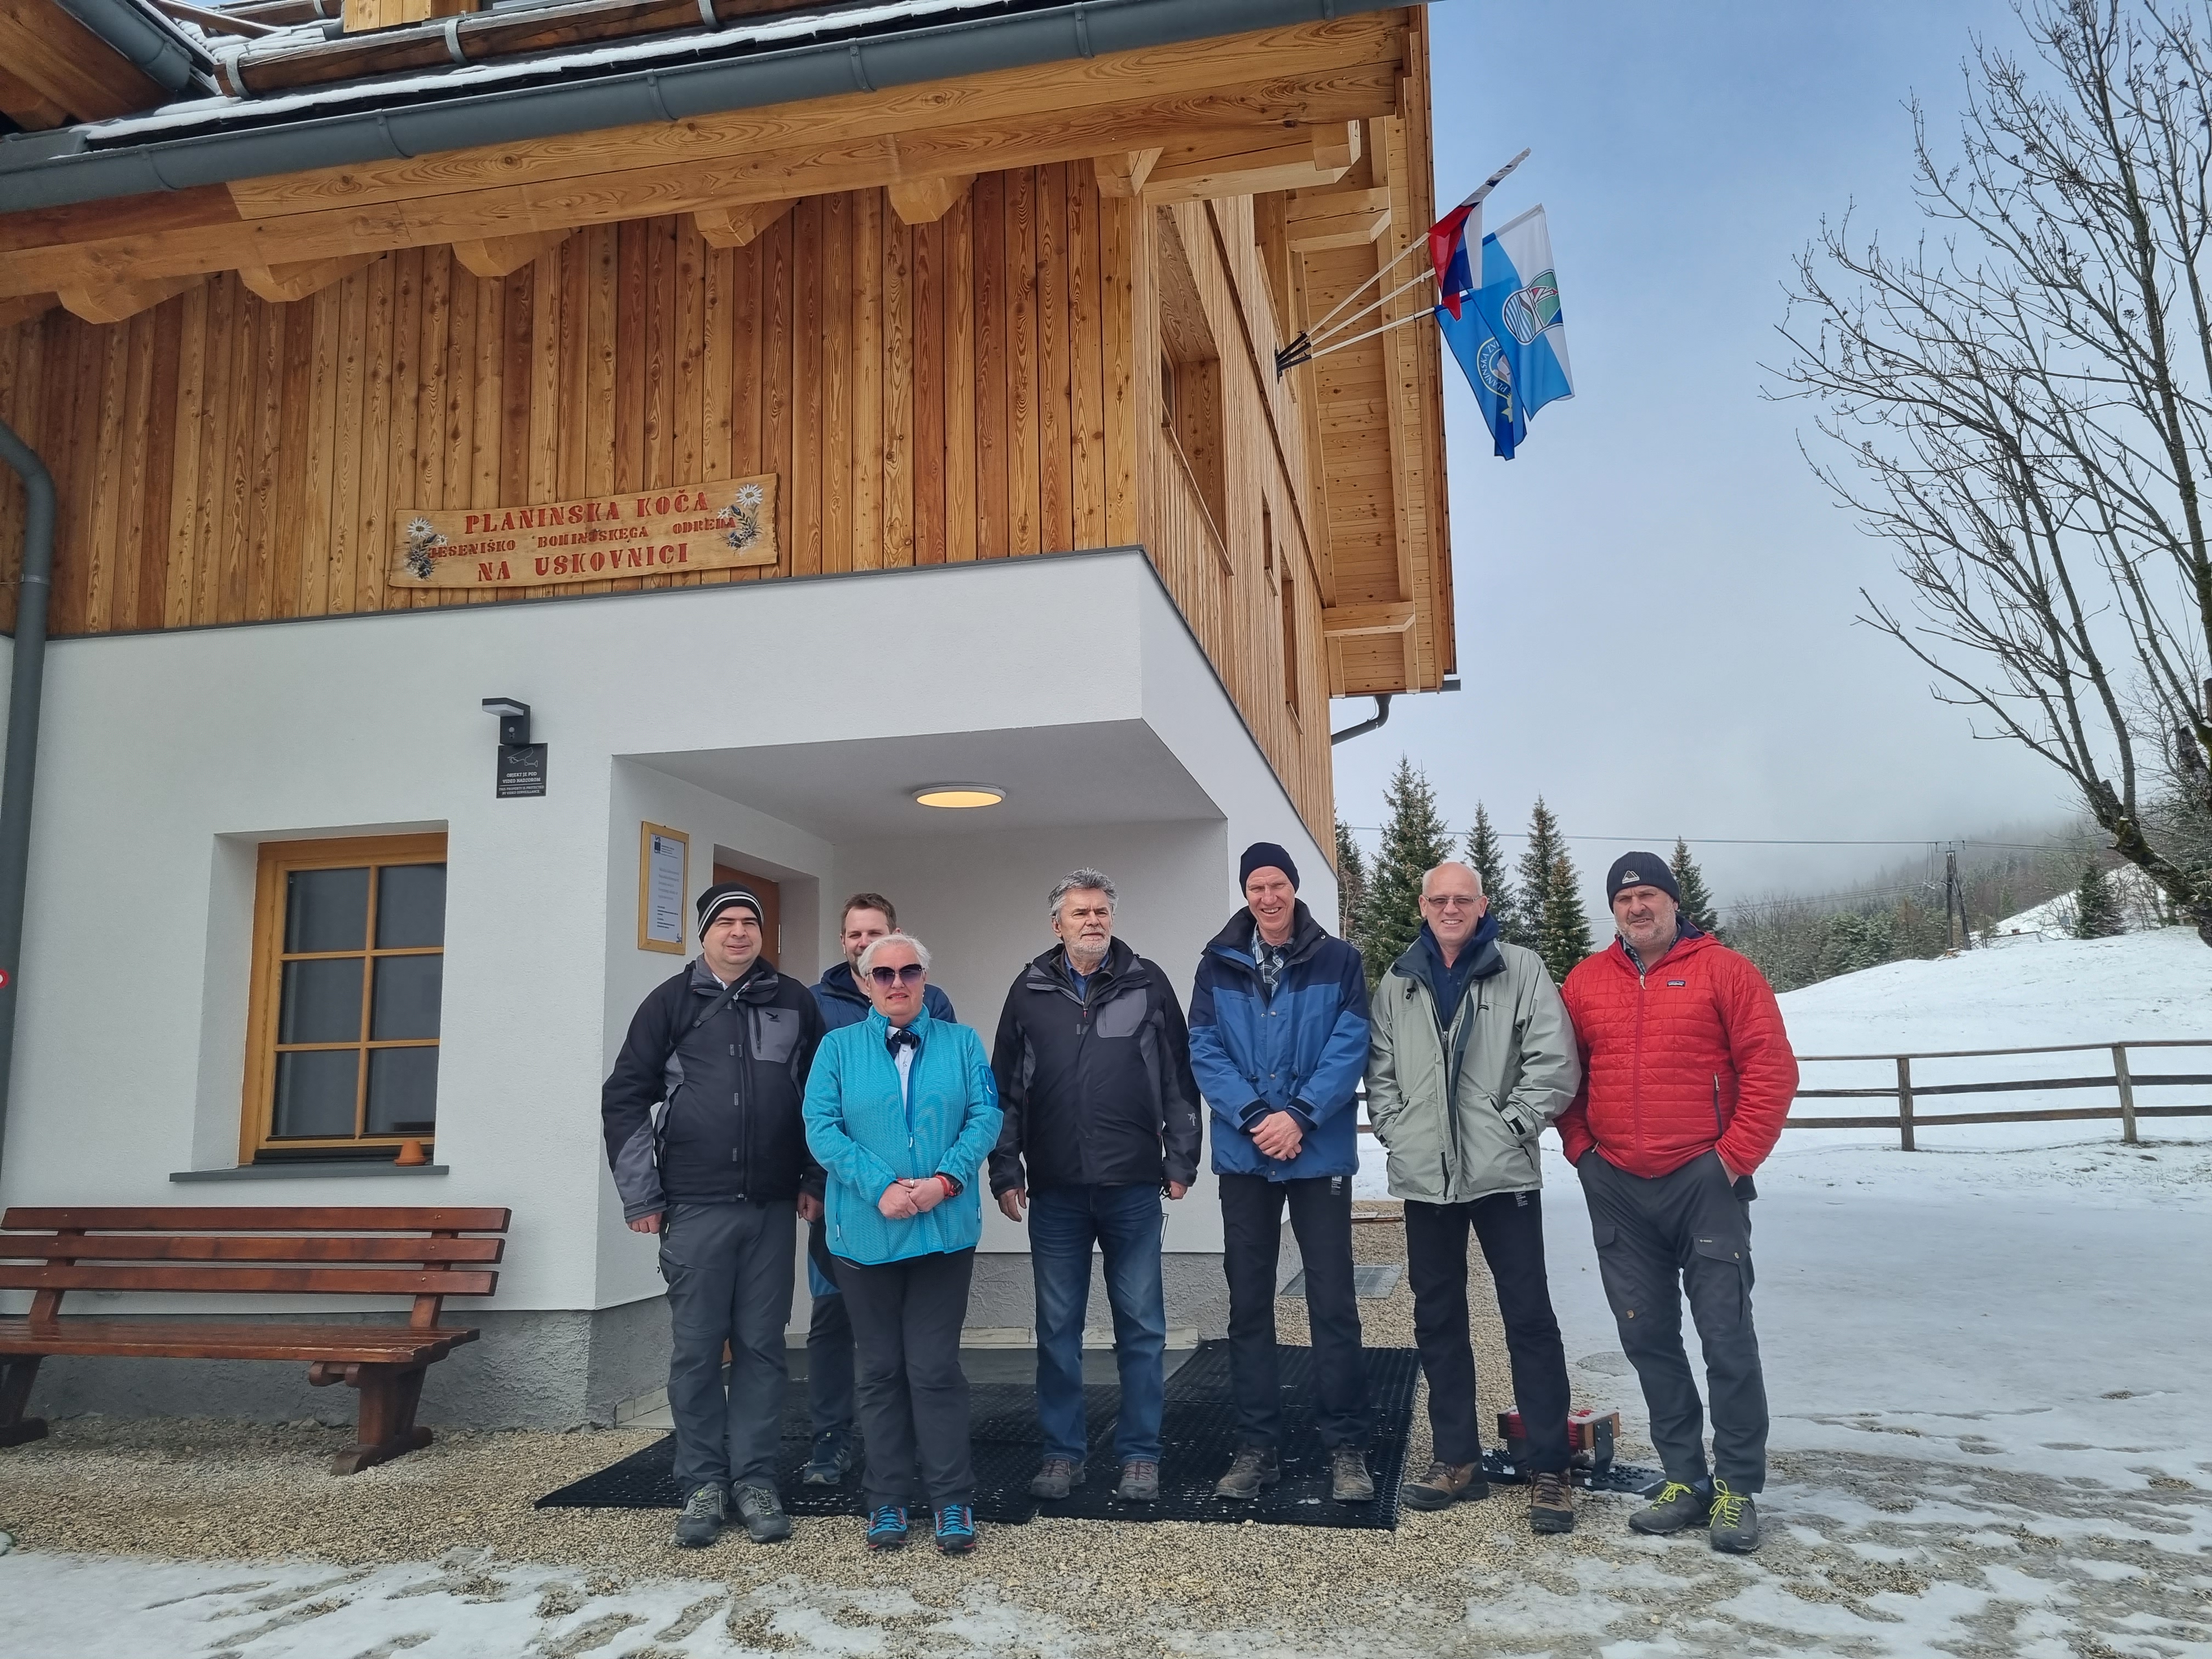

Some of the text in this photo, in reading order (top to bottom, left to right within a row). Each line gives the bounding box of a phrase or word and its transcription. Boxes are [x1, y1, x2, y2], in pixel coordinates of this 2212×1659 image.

[1480, 353, 1508, 393] PLANINSKA
[465, 489, 709, 534] PLANINSKA KOČA
[427, 517, 736, 558] JESENIŠKO BOHINJSKEGA ODREDA
[478, 543, 688, 582] NA USKOVNICI
